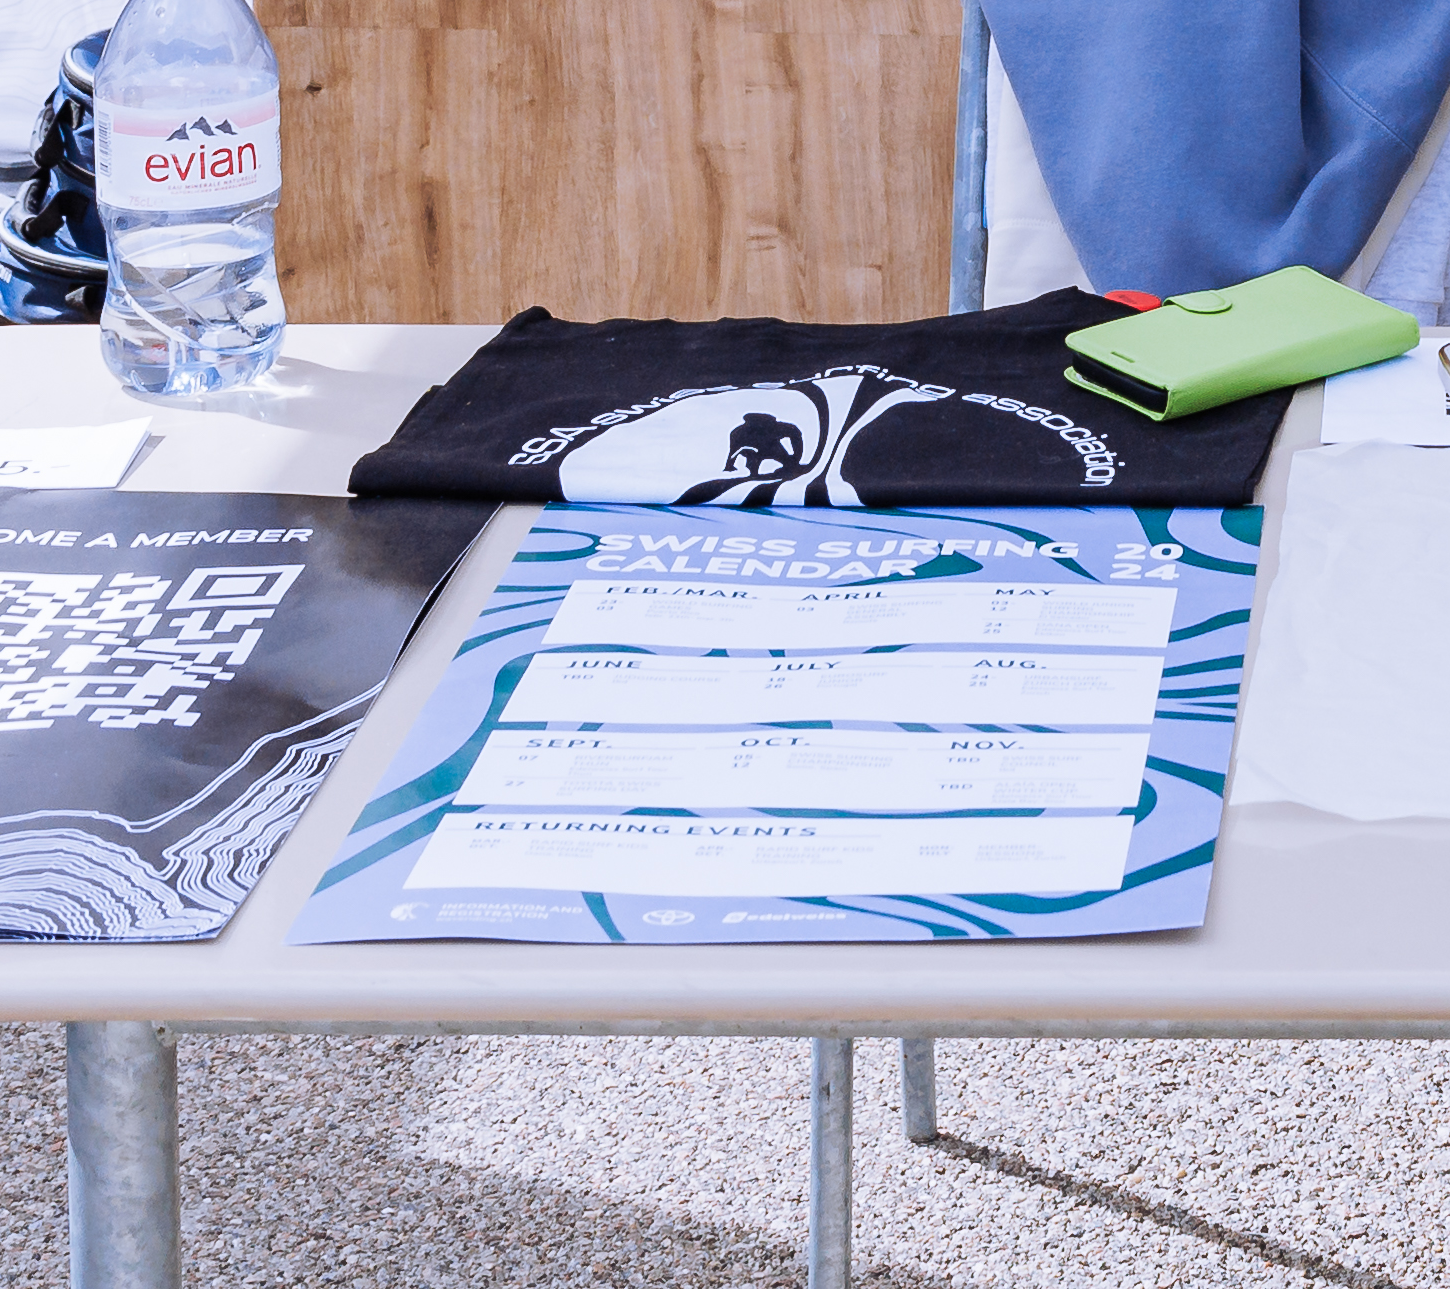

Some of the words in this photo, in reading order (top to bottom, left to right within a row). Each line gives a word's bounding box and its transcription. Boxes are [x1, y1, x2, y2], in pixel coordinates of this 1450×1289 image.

[144, 142, 257, 183] evian
[507, 425, 598, 466] SSA
[961, 392, 1126, 488] association
[84, 532, 119, 549] A
[129, 527, 314, 550] MEMBER
[594, 533, 797, 558] SWISS
[816, 538, 1079, 561] SURFING
[1113, 541, 1185, 561] 20
[584, 555, 918, 580] CALENDAR
[1108, 562, 1181, 581] 24
[800, 591, 887, 601] APRIL
[995, 588, 1056, 596] MAY
[566, 660, 643, 669] JUNE
[770, 660, 843, 672] JULY
[973, 659, 1047, 669] AUG.
[525, 738, 613, 748] SEPT.
[740, 737, 810, 747] OCT.
[950, 740, 1025, 750] NOV.
[474, 821, 670, 834] RETURNING
[686, 825, 817, 837] EVENTS
